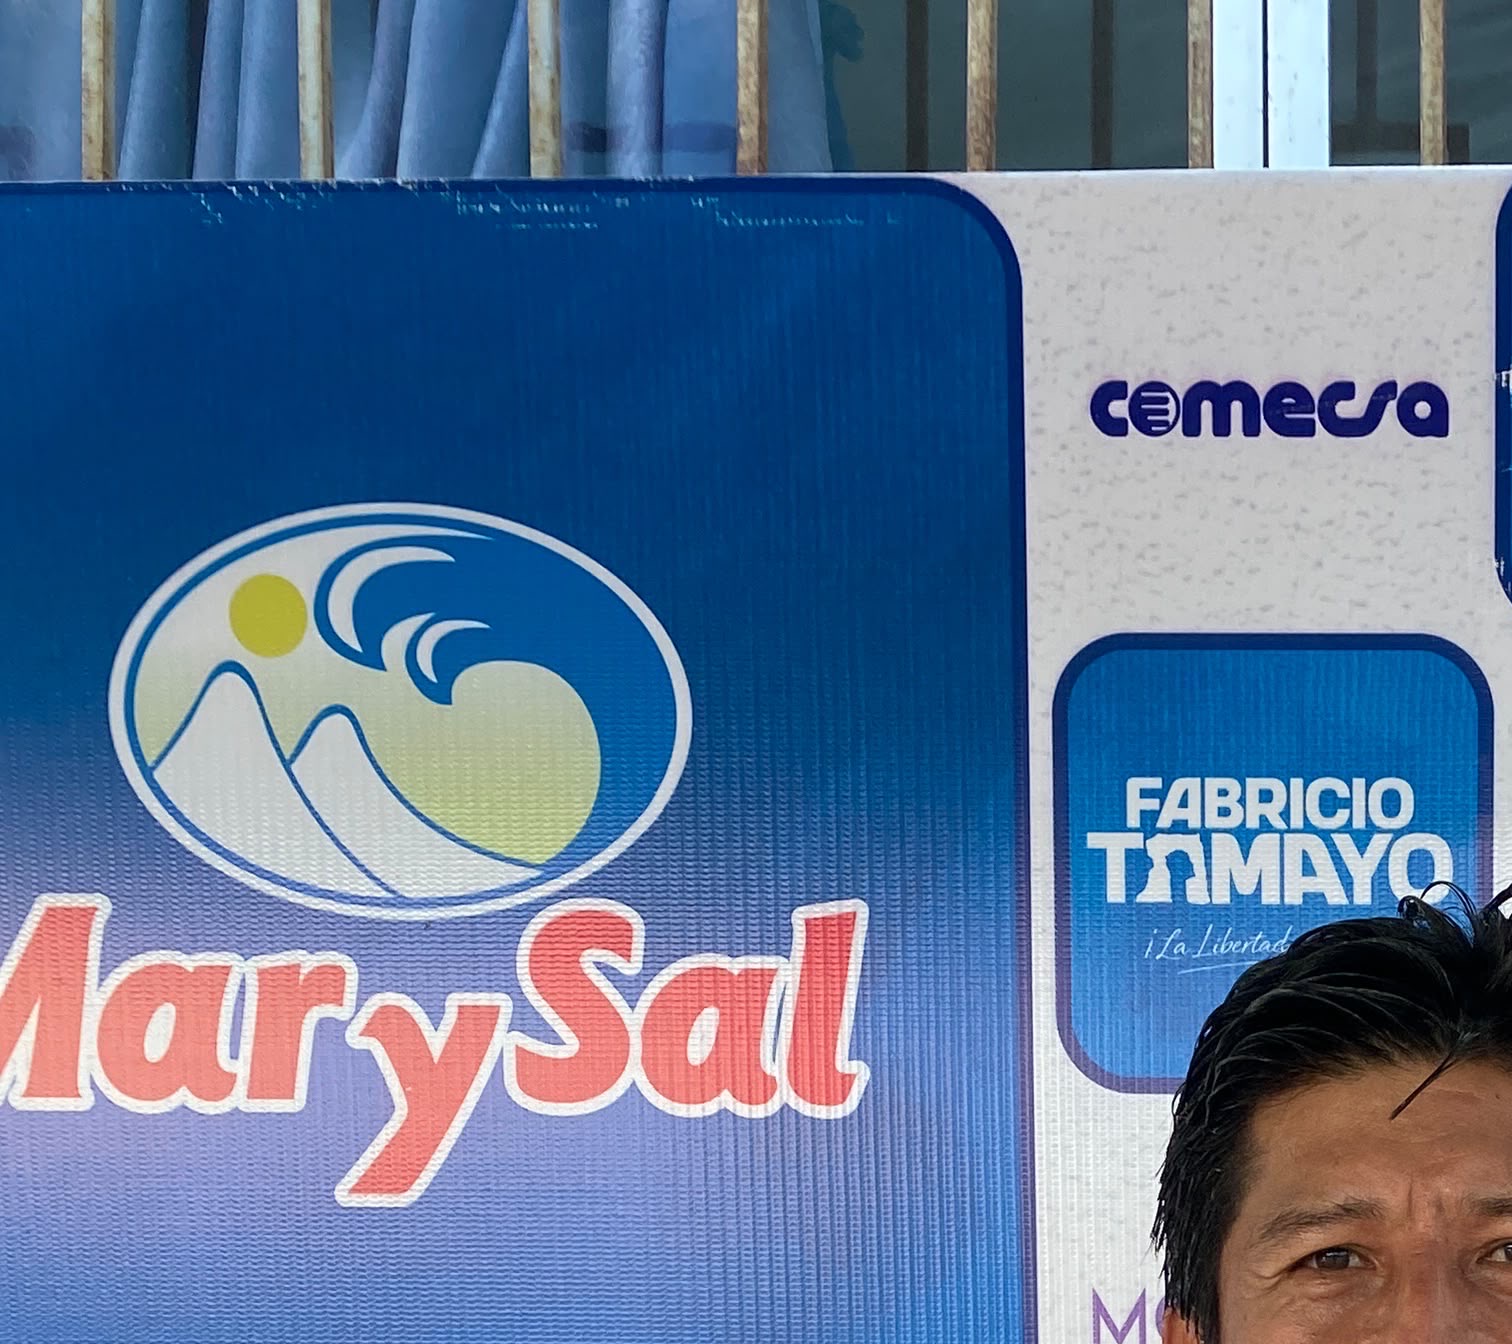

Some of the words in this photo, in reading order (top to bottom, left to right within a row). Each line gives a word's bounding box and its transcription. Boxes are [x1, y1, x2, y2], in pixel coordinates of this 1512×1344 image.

[1126, 777, 1415, 829] FABRICIO
[1086, 833, 1454, 905] TAMAYO
[1192, 924, 1294, 960] Libertad
